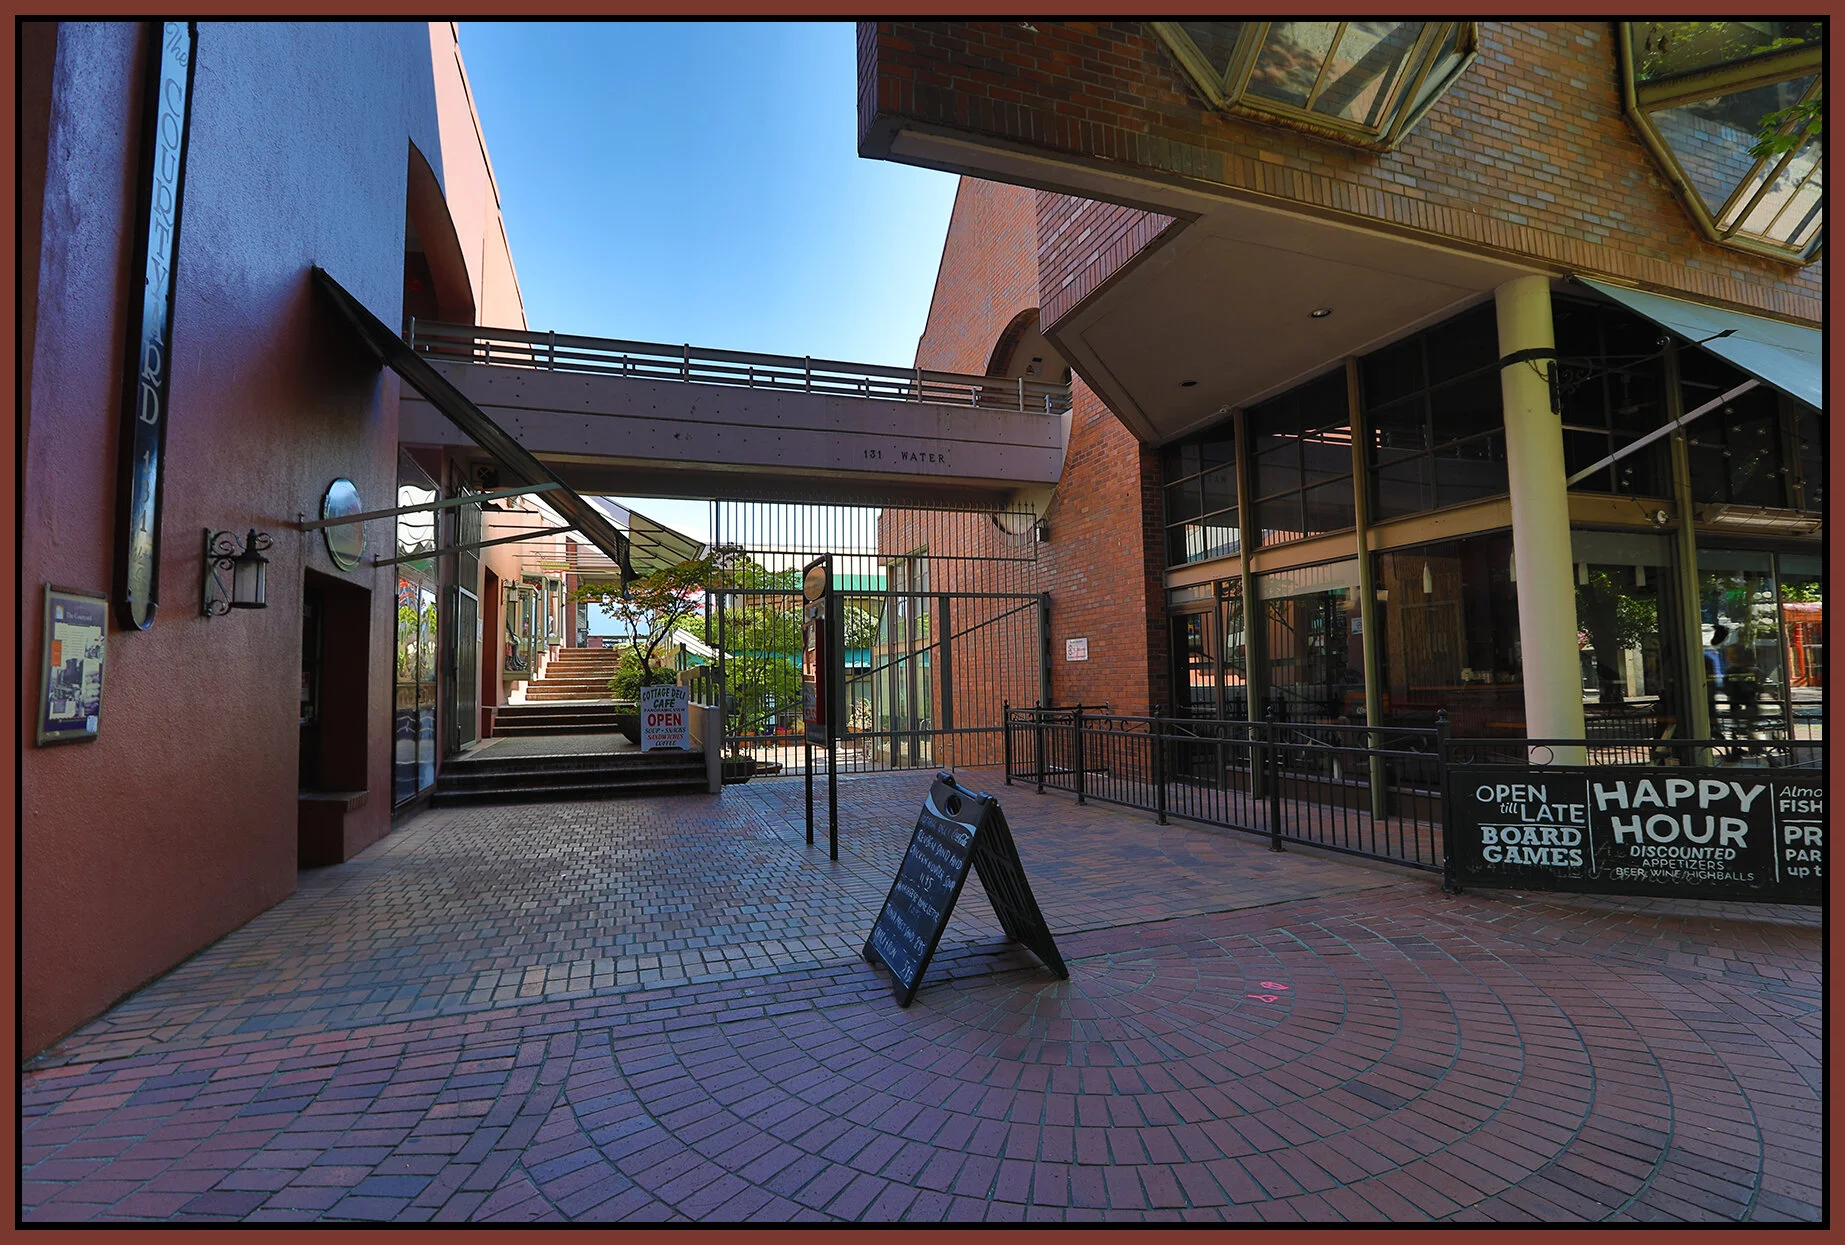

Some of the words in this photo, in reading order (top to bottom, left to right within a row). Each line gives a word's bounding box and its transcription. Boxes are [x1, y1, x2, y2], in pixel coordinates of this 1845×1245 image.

[164, 20, 189, 69] The
[139, 77, 183, 428] COURTYARD
[863, 449, 882, 460] 131
[900, 451, 945, 463] WATER
[138, 449, 151, 533] 131
[66, 611, 74, 620] The
[643, 688, 670, 701] COTTAGE
[671, 688, 686, 701] DELI
[647, 713, 682, 727] OPEN
[1476, 784, 1547, 803] OPEN
[1593, 778, 1767, 813] HAPPY
[1779, 786, 1822, 798] Almo
[1500, 802, 1518, 814] till
[1520, 803, 1585, 823] LATE
[1780, 799, 1822, 813] FISH
[1480, 826, 1582, 847] BOARD
[1611, 813, 1748, 848] HOUR
[1784, 825, 1822, 846] PR
[1482, 845, 1584, 867] GAMES
[1630, 845, 1737, 860] DISCOUNTED
[1785, 848, 1822, 862] PAR
[1642, 858, 1725, 871] APPETIZERS
[1787, 866, 1810, 879] up
